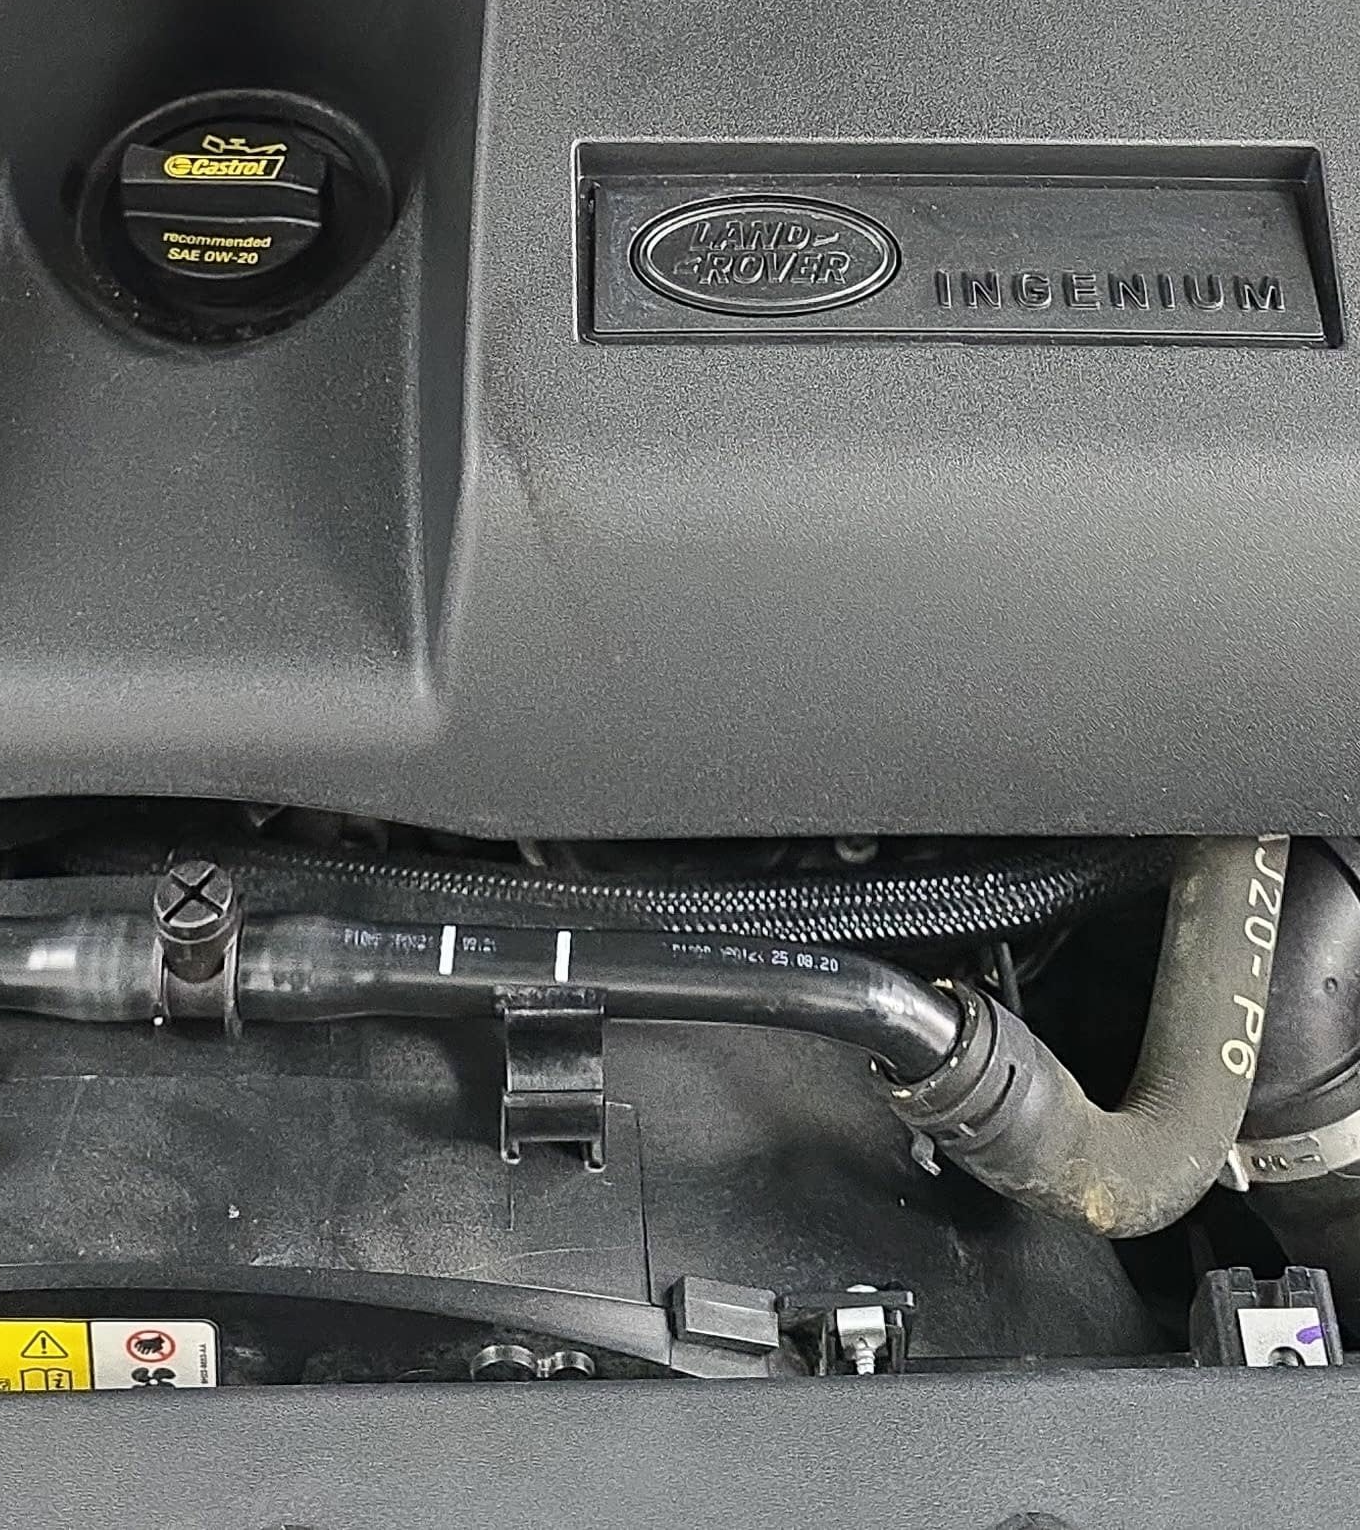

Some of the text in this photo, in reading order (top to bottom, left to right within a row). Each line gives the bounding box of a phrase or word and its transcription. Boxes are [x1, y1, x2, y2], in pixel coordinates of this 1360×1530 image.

[191, 158, 268, 175] Castrol
[162, 232, 273, 248] recommended
[167, 247, 259, 264] SAE 0W-20
[698, 251, 852, 285] ROVER
[934, 269, 1286, 313] INGENIUM
